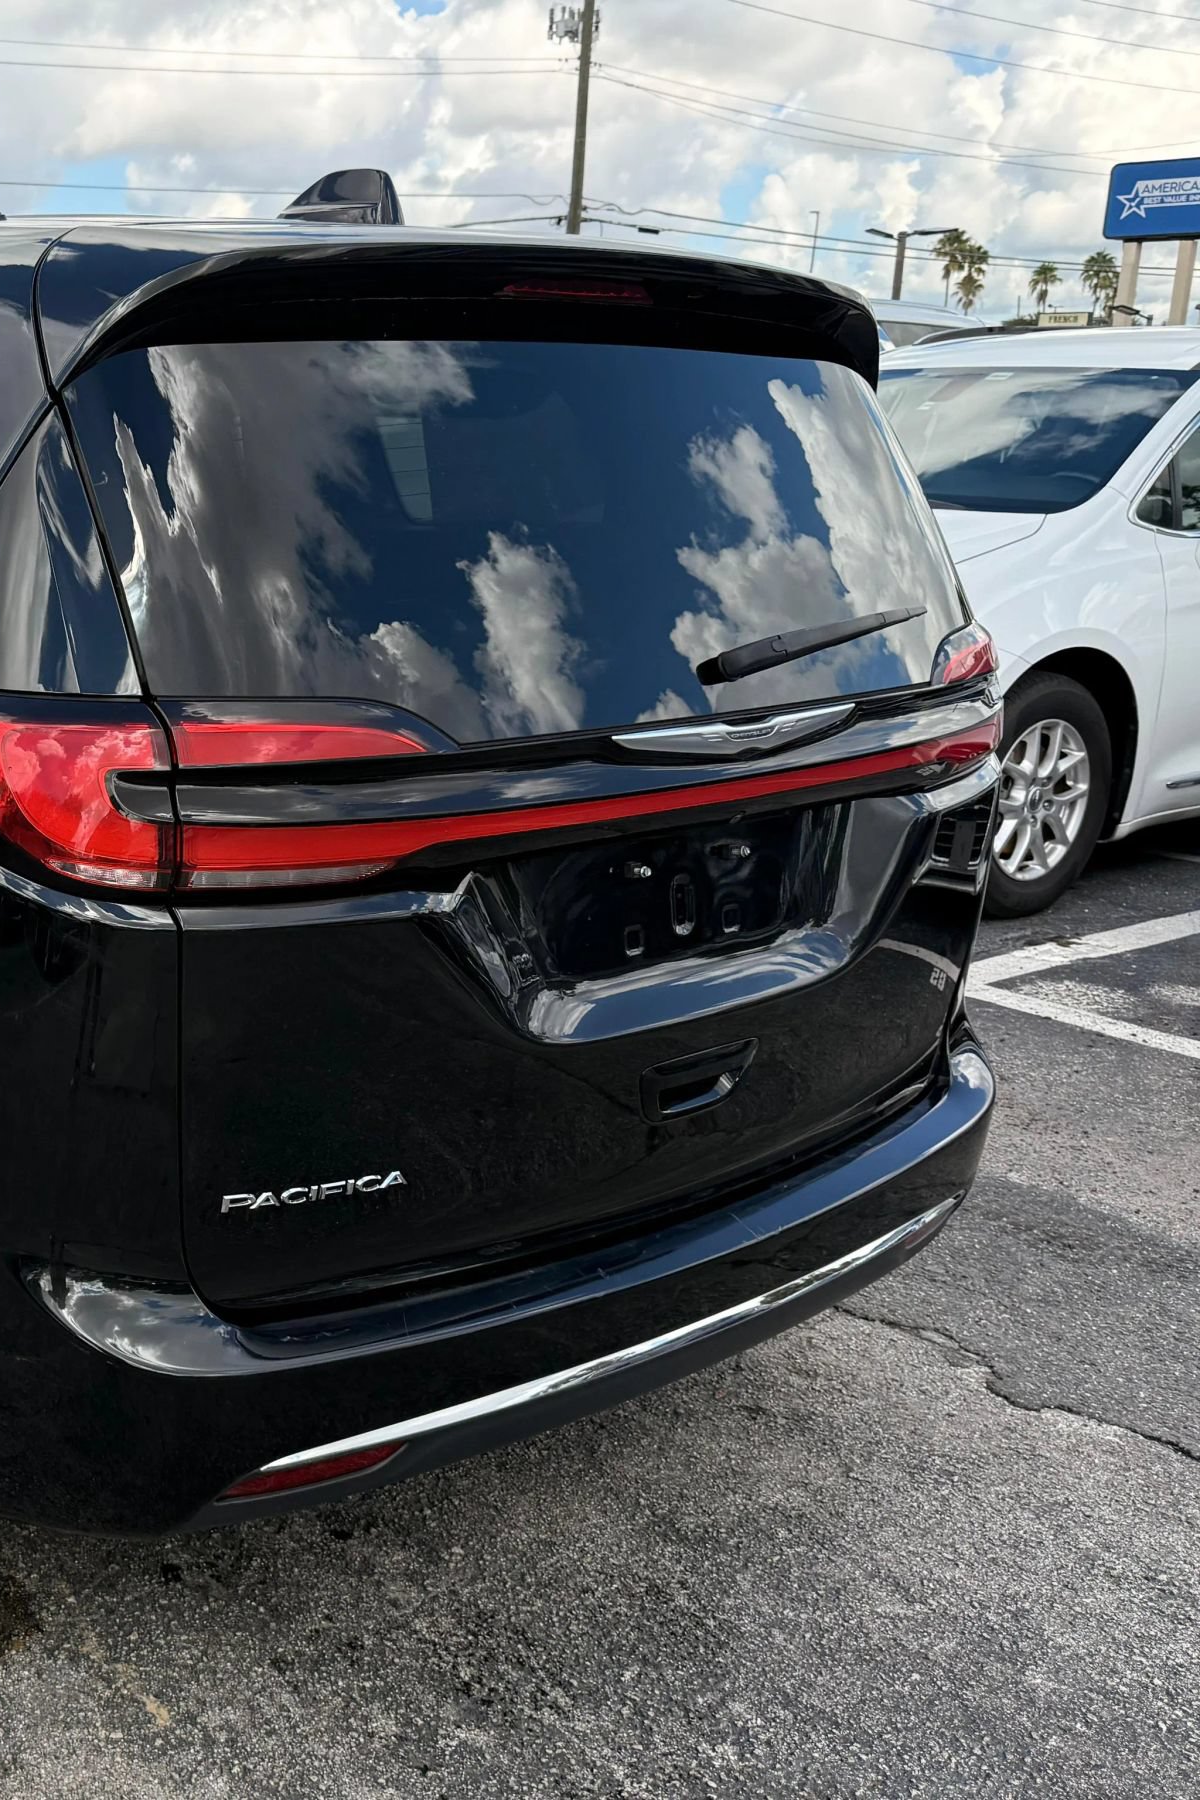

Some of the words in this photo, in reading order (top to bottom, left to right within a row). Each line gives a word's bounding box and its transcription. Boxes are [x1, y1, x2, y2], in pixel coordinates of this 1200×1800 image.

[1141, 180, 1200, 194] AMERICA
[1143, 196, 1162, 205] BEST
[220, 1170, 408, 1213] PACIFICA
